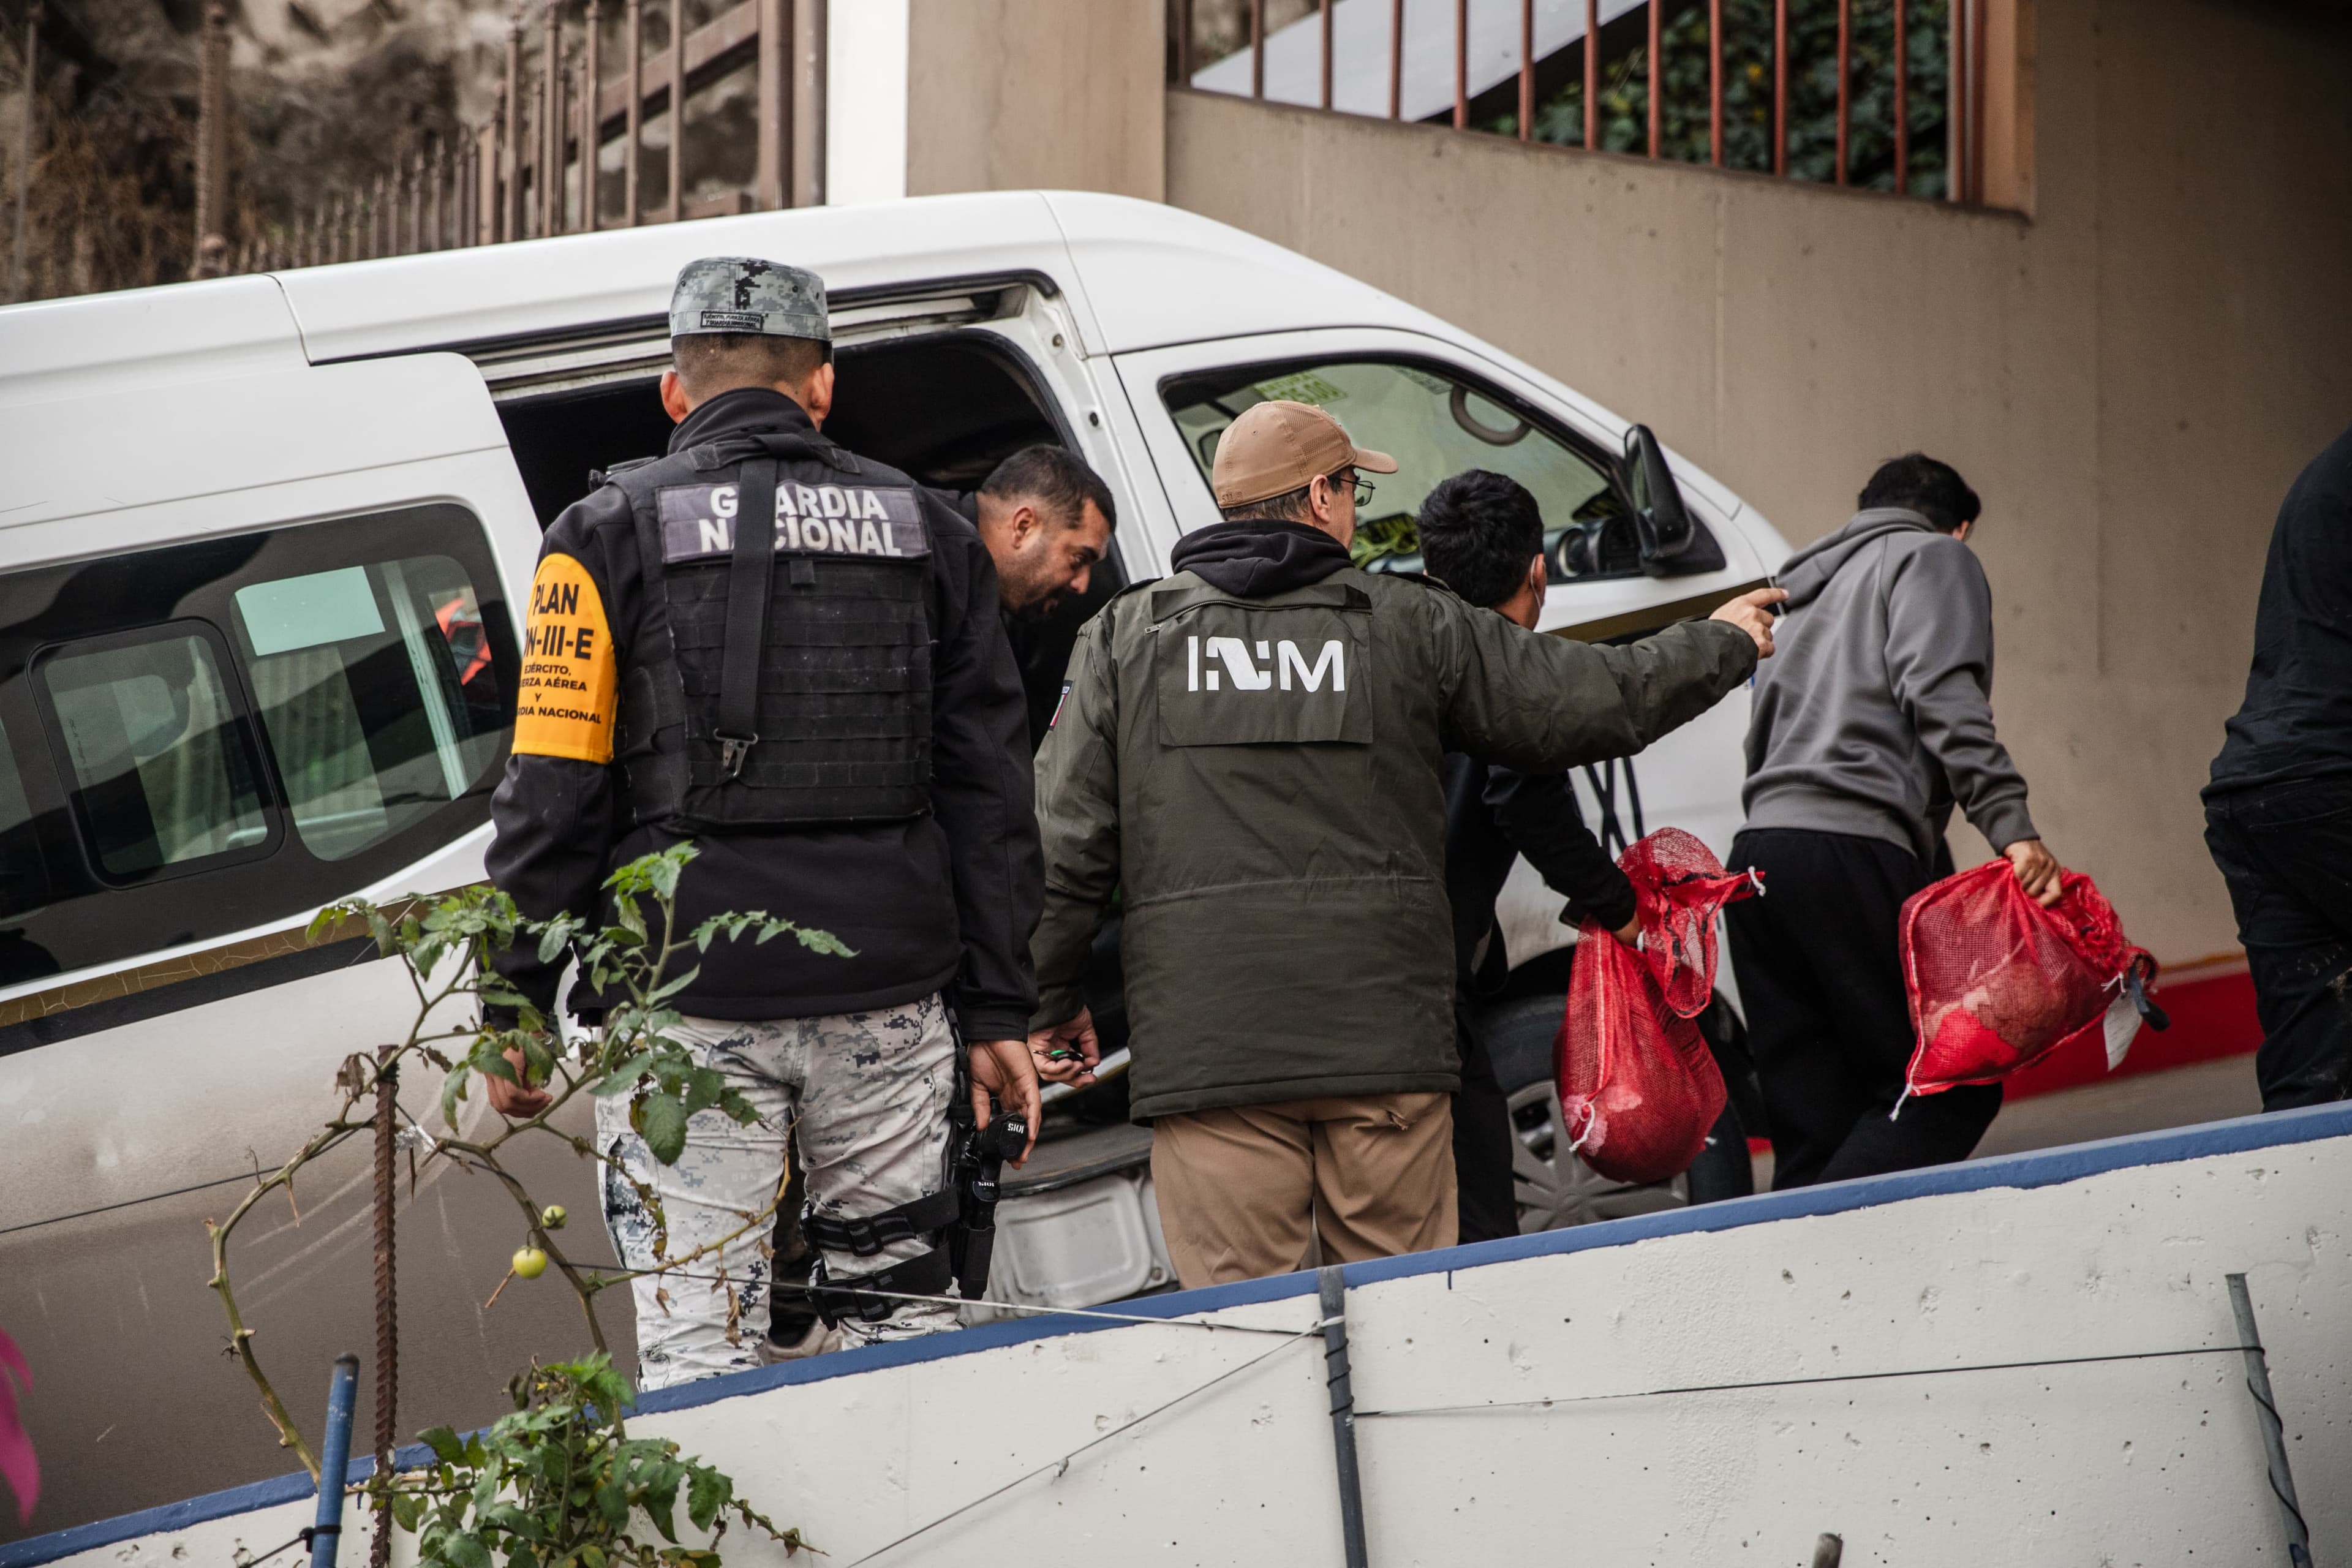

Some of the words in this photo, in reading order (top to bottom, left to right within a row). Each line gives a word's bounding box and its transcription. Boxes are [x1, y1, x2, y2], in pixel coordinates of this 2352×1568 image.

[710, 483, 889, 521] GARDIA
[698, 516, 902, 557] NIONAL
[532, 582, 579, 616] PLAN
[524, 662, 571, 677] EJÉRCITO,
[1188, 635, 1345, 693] INM
[544, 676, 587, 692] AÉREA
[535, 692, 541, 703] Y
[538, 707, 601, 724] NACIONAL
